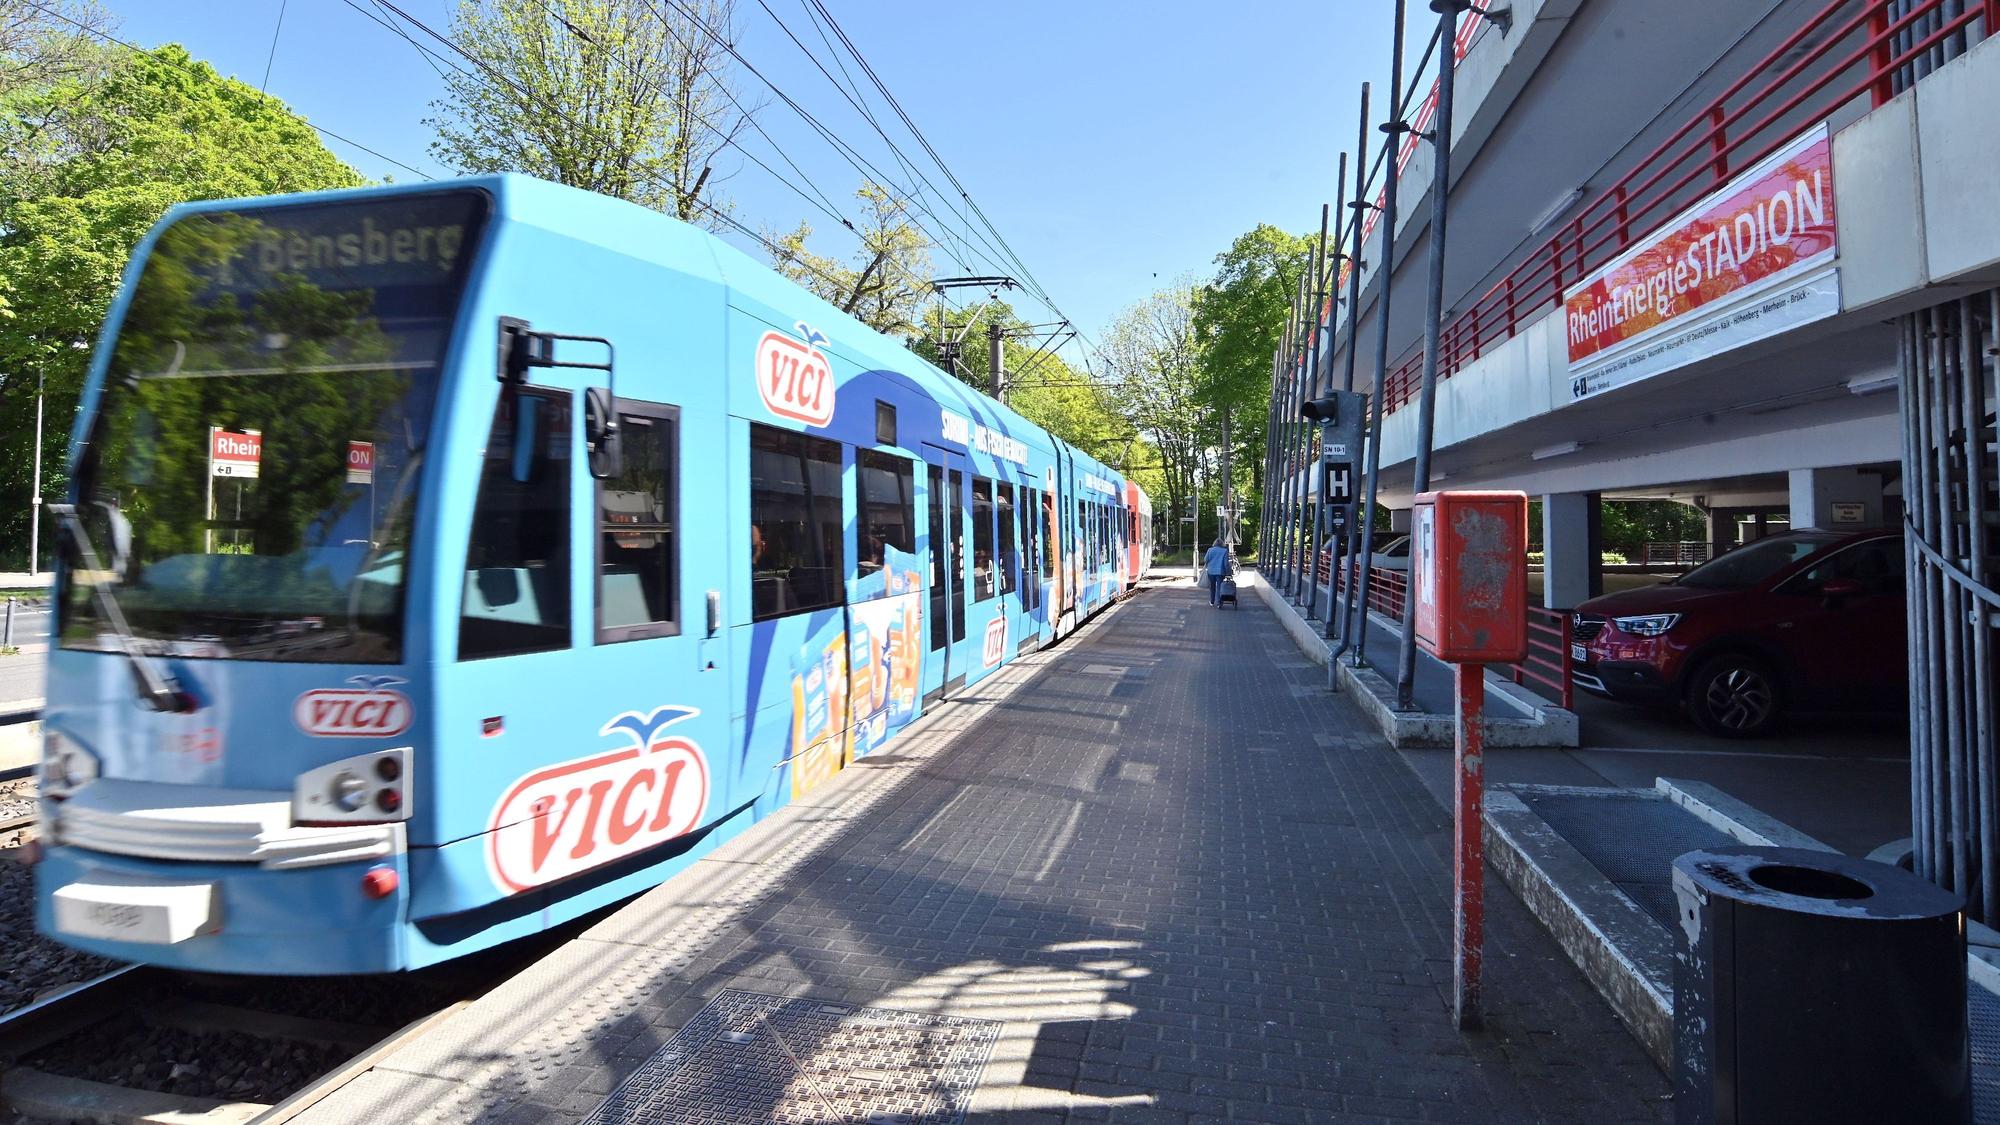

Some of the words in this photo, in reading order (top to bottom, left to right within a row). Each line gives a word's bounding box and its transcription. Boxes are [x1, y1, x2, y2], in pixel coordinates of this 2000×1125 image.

[1569, 169, 1825, 348] RheinEnergieSTADION
[1762, 299, 1787, 314] Merheim
[1790, 290, 1807, 304] Brück
[770, 350, 826, 412] VICI
[217, 437, 261, 457] Rhein
[350, 450, 370, 464] ON
[1329, 470, 1348, 497] H
[309, 699, 395, 730] VICI
[530, 758, 686, 873] VICI
